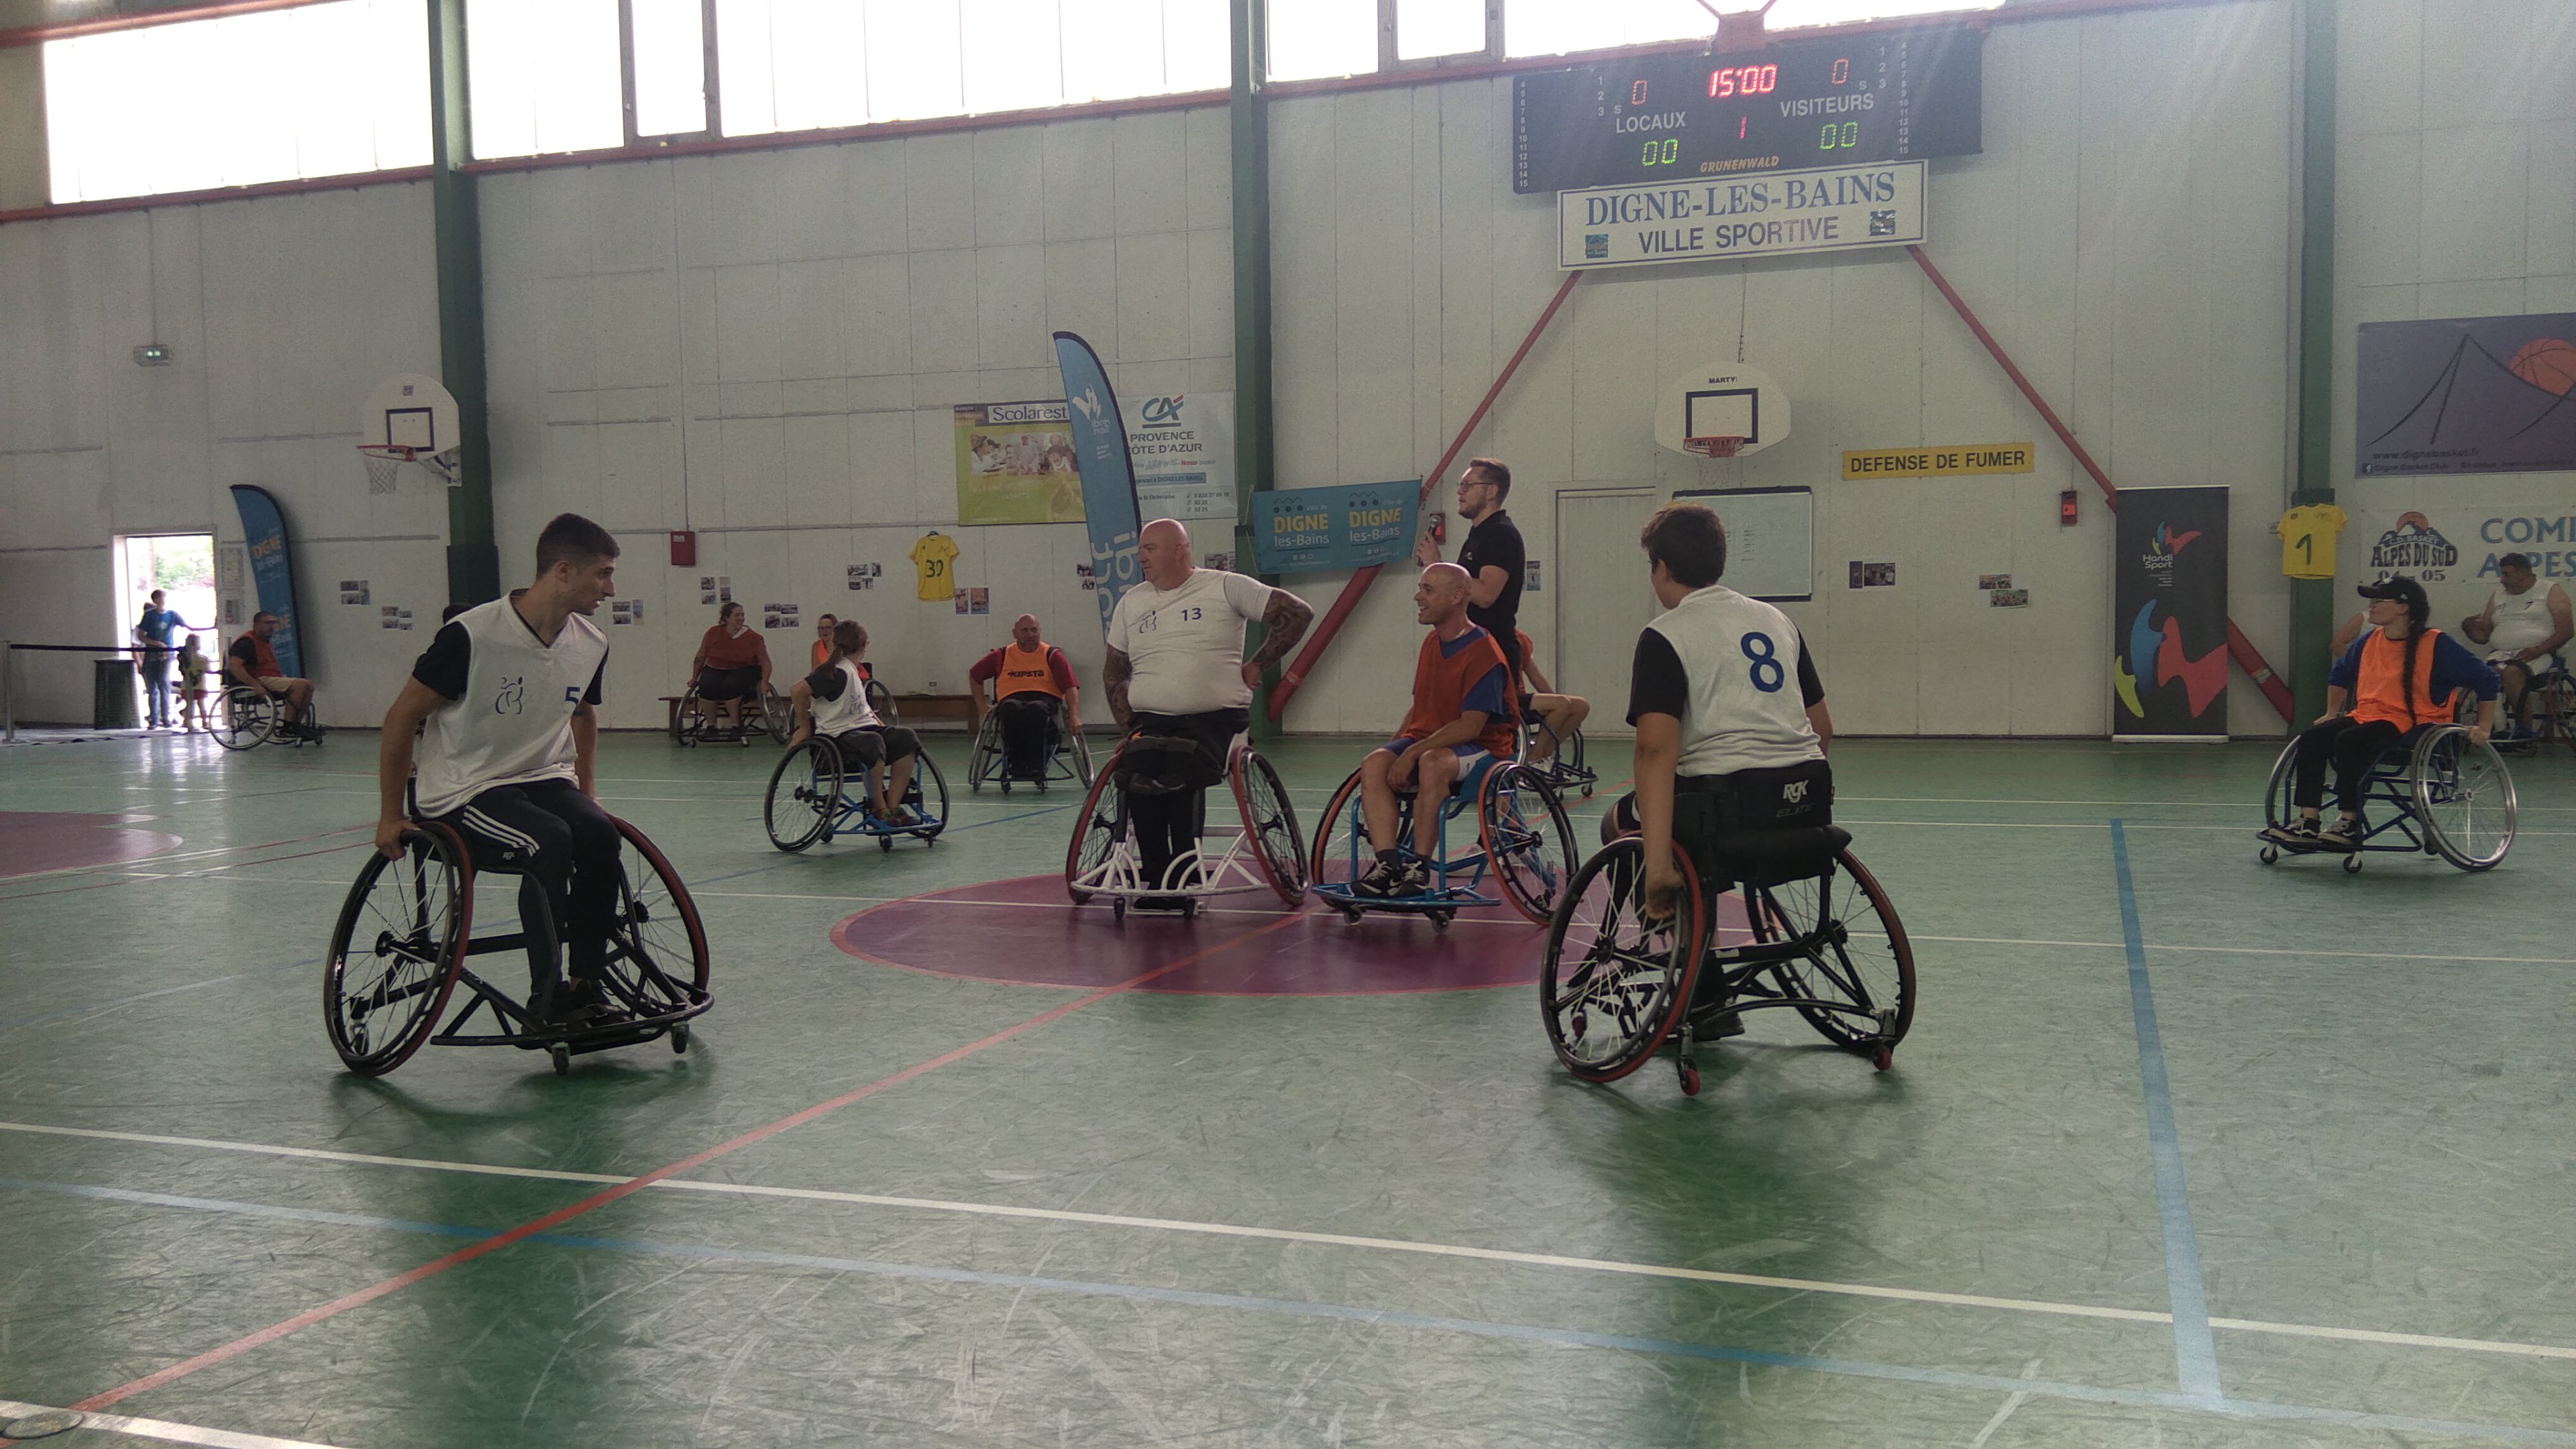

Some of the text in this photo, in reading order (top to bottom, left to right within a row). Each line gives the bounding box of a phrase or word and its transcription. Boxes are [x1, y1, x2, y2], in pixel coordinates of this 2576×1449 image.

[1880, 46, 1885, 56] 1
[1831, 58, 1849, 85] 0
[1879, 62, 1886, 72] 2
[1598, 76, 1603, 85] 1
[1709, 65, 1778, 97] 15:00
[1879, 78, 1886, 89] 3
[1597, 91, 1604, 100] 2
[1631, 80, 1648, 105] 0
[1598, 107, 1604, 116] 3
[1780, 93, 1874, 117] VISITEURS
[1616, 111, 1686, 133] LOCAUX
[1739, 116, 1747, 140] 1
[1820, 121, 1858, 150] 00
[1642, 138, 1678, 166] 00
[1700, 156, 1780, 173] GRUNENWALD
[1586, 172, 1895, 226] DIGNE-LES-BAINS
[1638, 227, 1704, 254] VILLE
[1715, 216, 1839, 248] SPORTIVE
[993, 405, 1068, 421] Scolarest
[1130, 431, 1195, 443] PROVENCE
[1128, 443, 1203, 455] ÔTE D'AZUR
[1851, 451, 2025, 473] DEFENSE DE FUMER
[1273, 513, 1329, 533] DIGNE
[1348, 507, 1402, 528] DIGNE
[1274, 534, 1330, 547] les-Bains
[1350, 526, 1400, 542] les-Bains
[2145, 561, 2174, 570] Sport
[2371, 543, 2458, 568] ALPES DU SUD
[2477, 551, 2576, 578] APES
[2422, 570, 2447, 582] 05
[1181, 607, 1202, 621] 13
[1741, 632, 1784, 693] 8
[565, 686, 582, 716] 5
